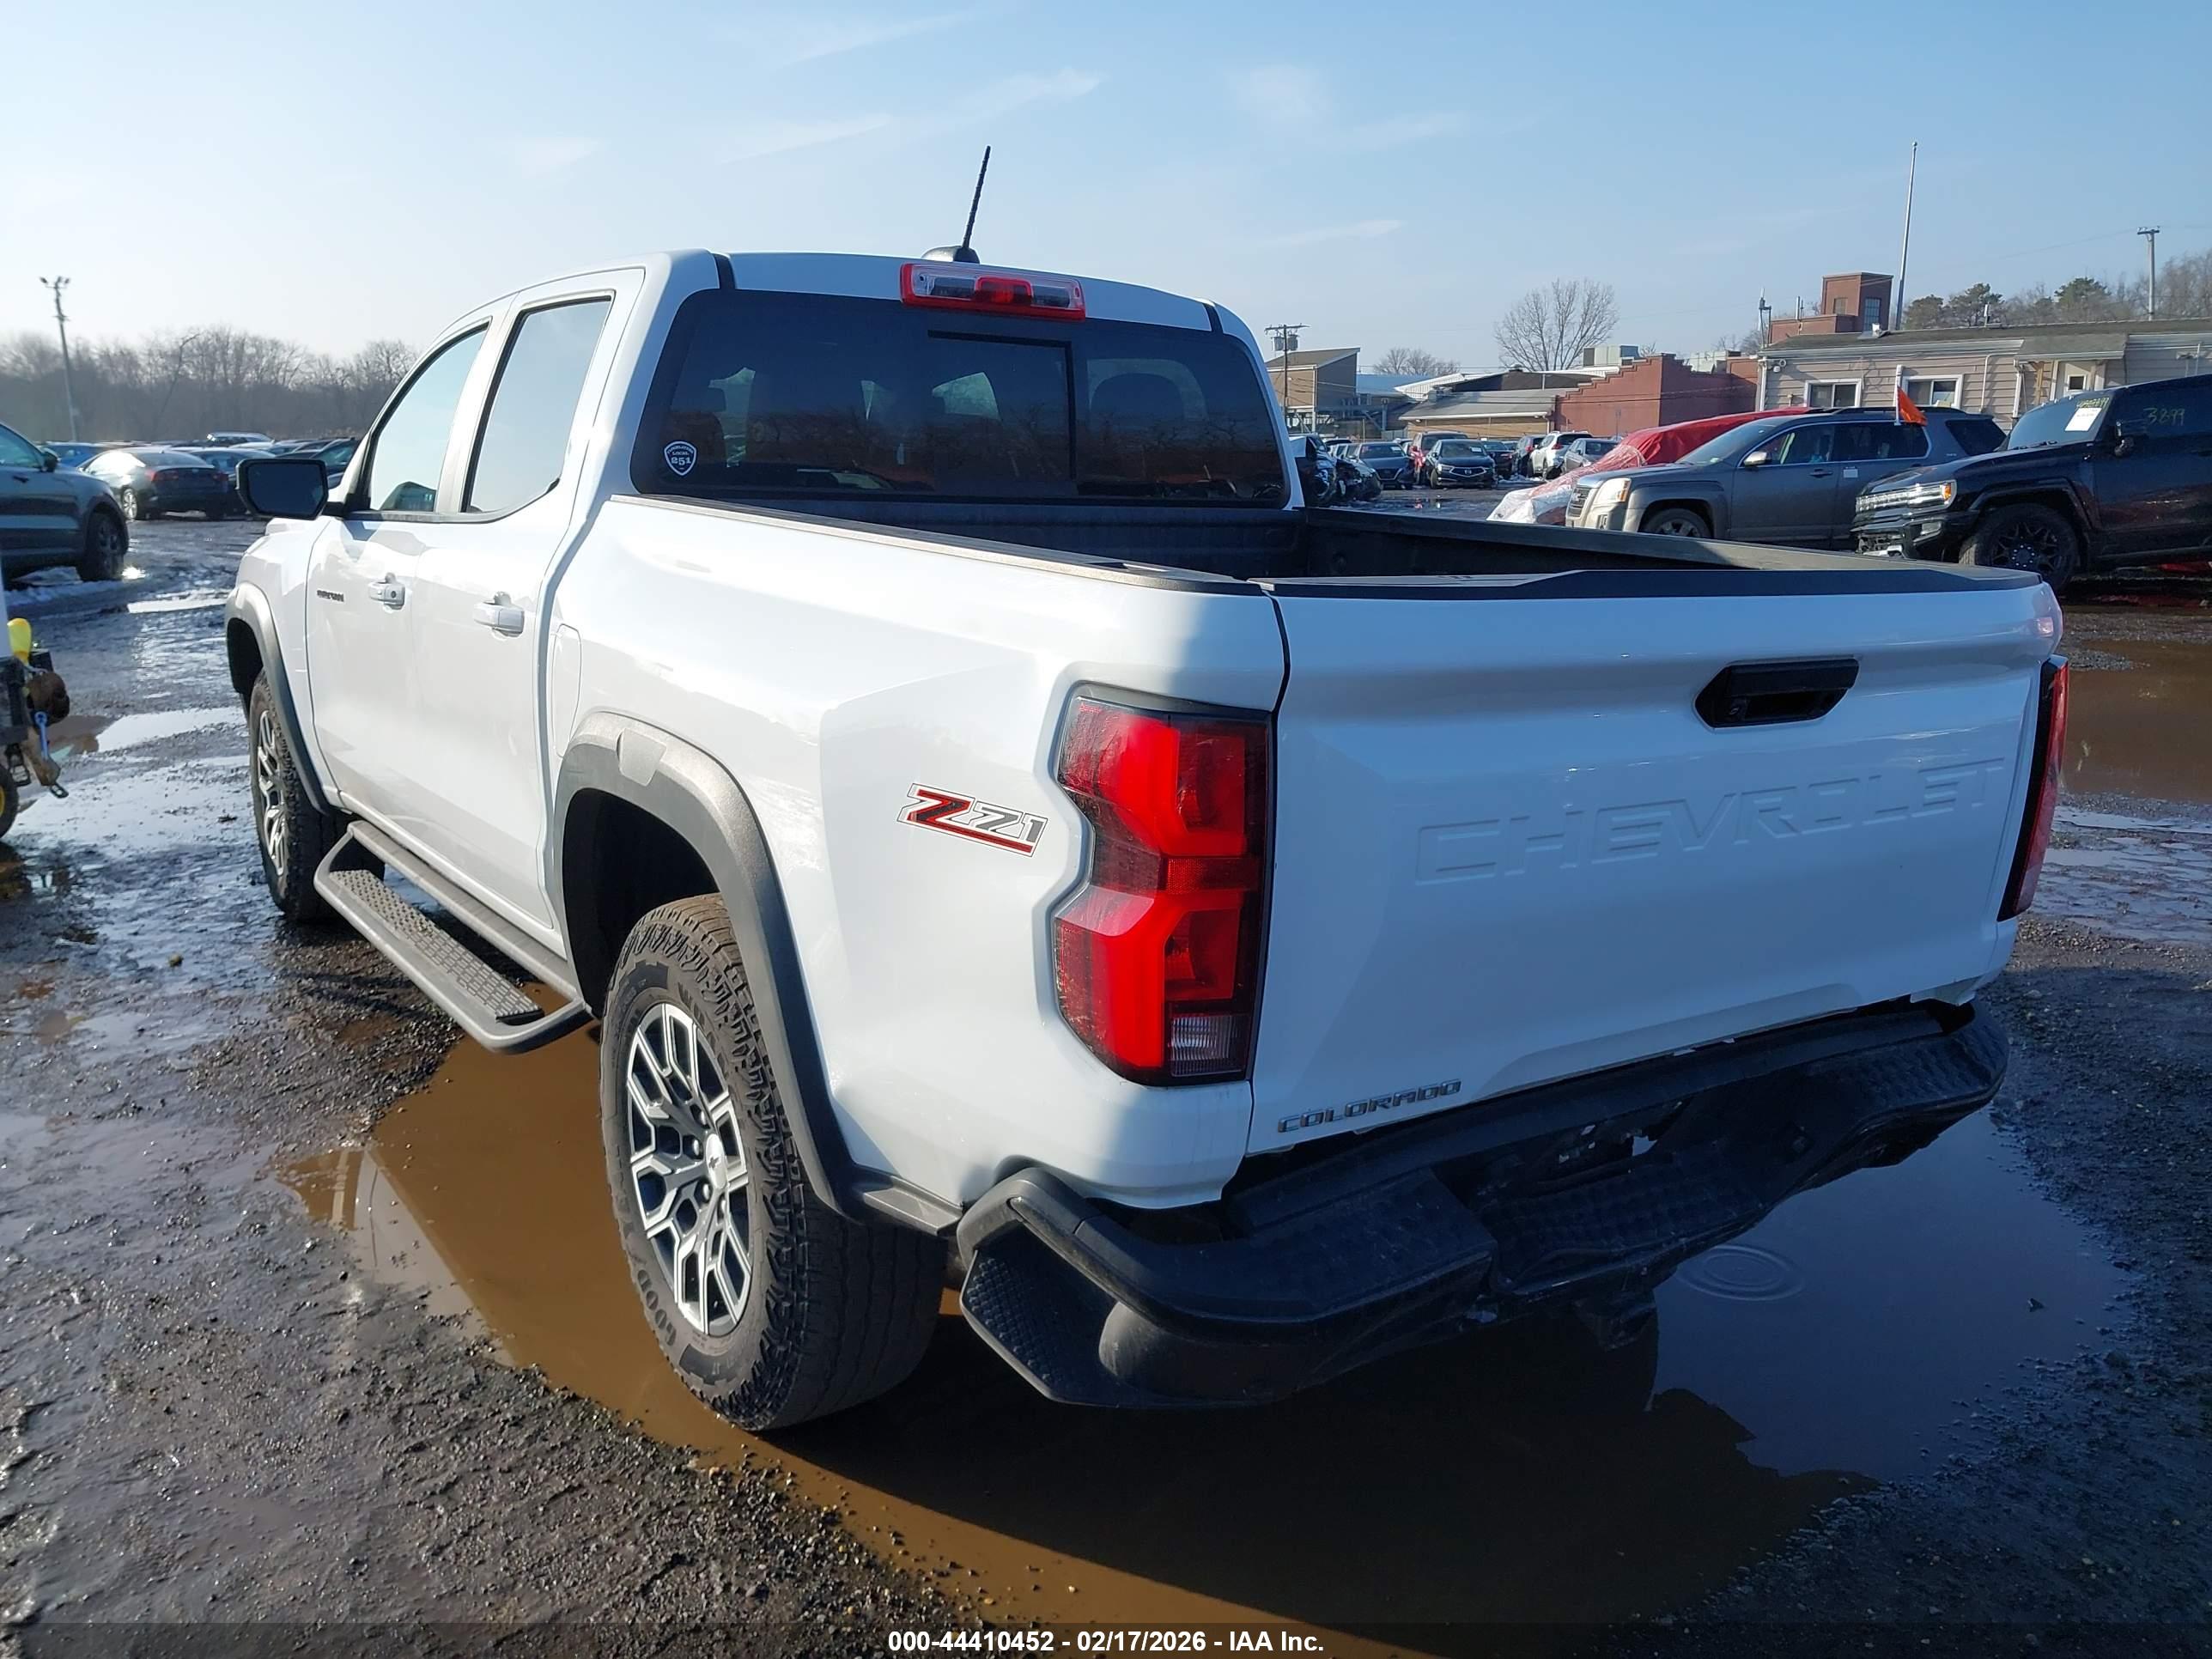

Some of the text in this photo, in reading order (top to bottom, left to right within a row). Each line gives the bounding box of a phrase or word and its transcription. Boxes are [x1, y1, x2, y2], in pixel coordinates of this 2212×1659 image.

[671, 457, 691, 465] 251
[898, 783, 1048, 855] Z71
[1414, 757, 2007, 886] CHEVROLET
[1277, 1079, 1462, 1133] COLORADO
